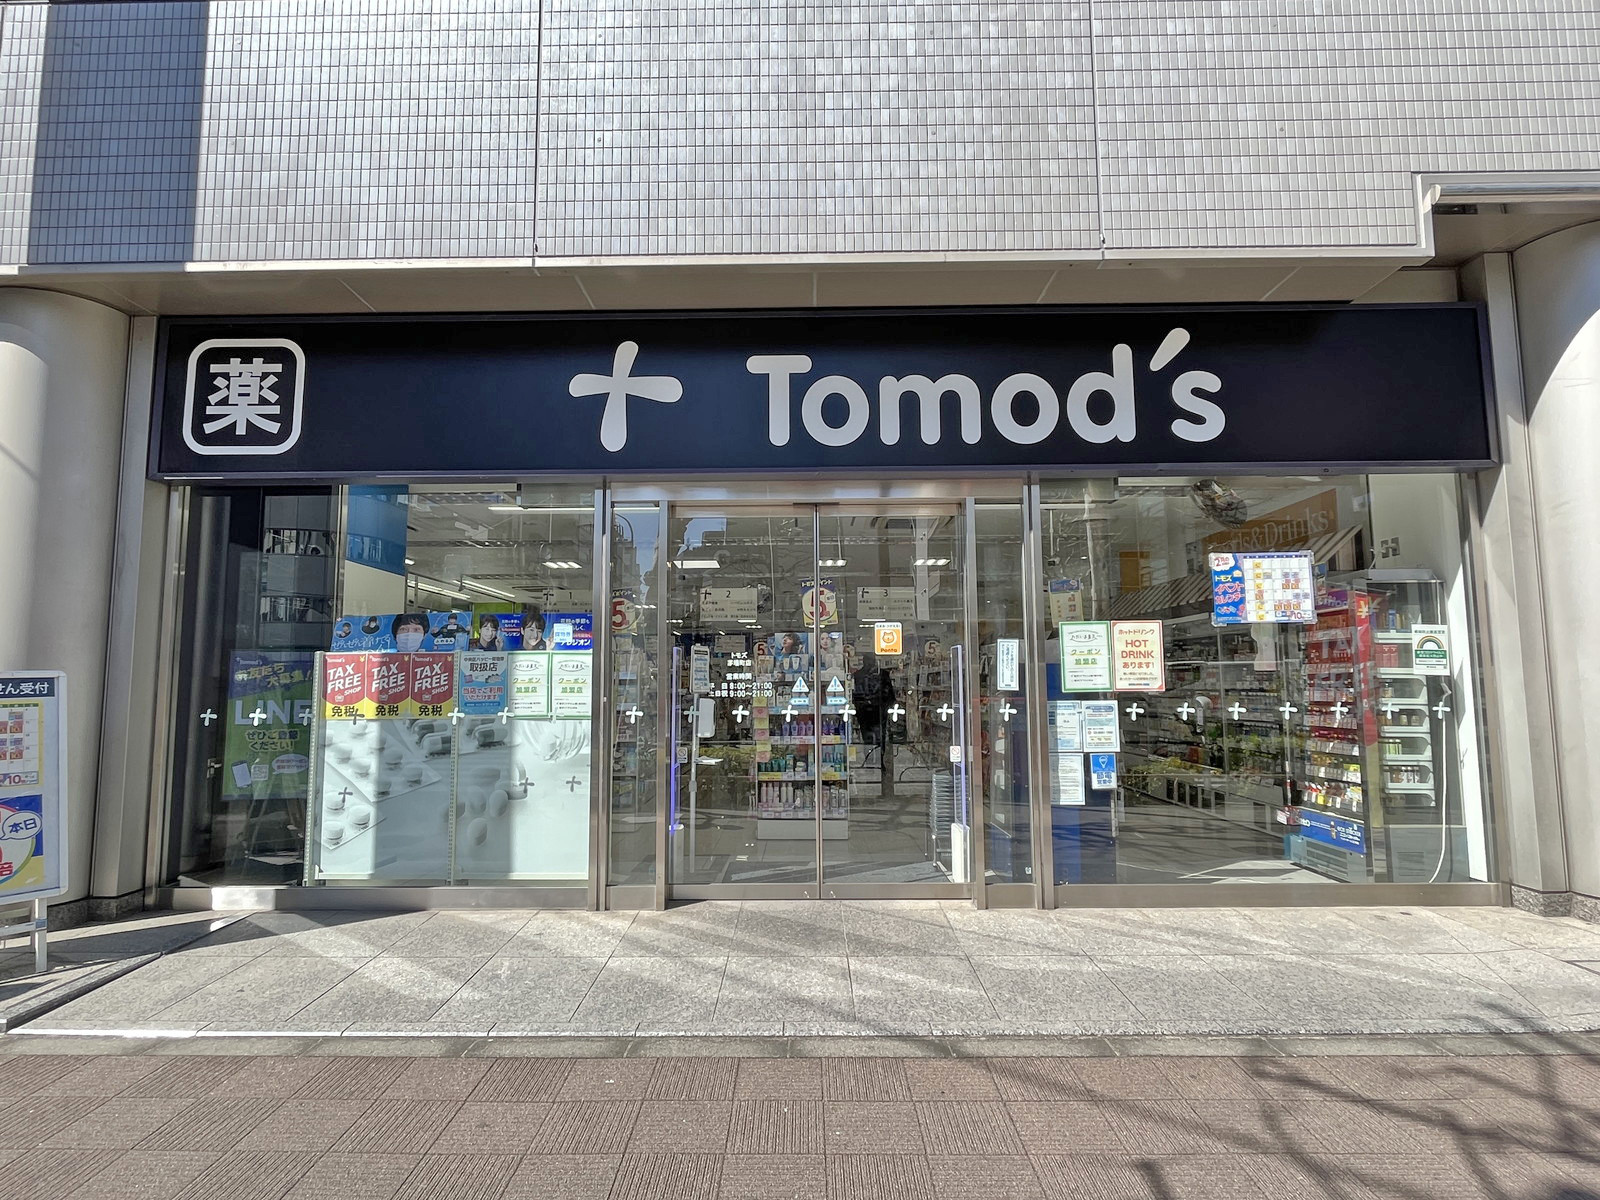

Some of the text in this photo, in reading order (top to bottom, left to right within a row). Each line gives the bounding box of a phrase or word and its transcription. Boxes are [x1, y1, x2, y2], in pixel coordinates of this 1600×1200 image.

[746, 328, 1226, 447] Tomod's
[203, 358, 282, 435] 薬
[883, 589, 888, 598] 3
[1125, 639, 1148, 648] HOT
[1121, 650, 1154, 658] DRINK
[327, 663, 355, 680] TAX
[371, 662, 399, 680] TAX
[414, 662, 442, 680] TAX
[470, 662, 498, 672] 取扱店
[327, 673, 361, 693] FREE
[371, 672, 405, 692] FREE
[414, 672, 448, 692] FREE
[344, 686, 361, 696] SHOP
[388, 685, 405, 695] SHOP
[431, 685, 448, 695] SHOP
[235, 700, 312, 724] LINE
[332, 705, 356, 717] 免税
[376, 705, 399, 716] 免税
[418, 705, 442, 716] 免税
[8, 818, 37, 833] 本日
